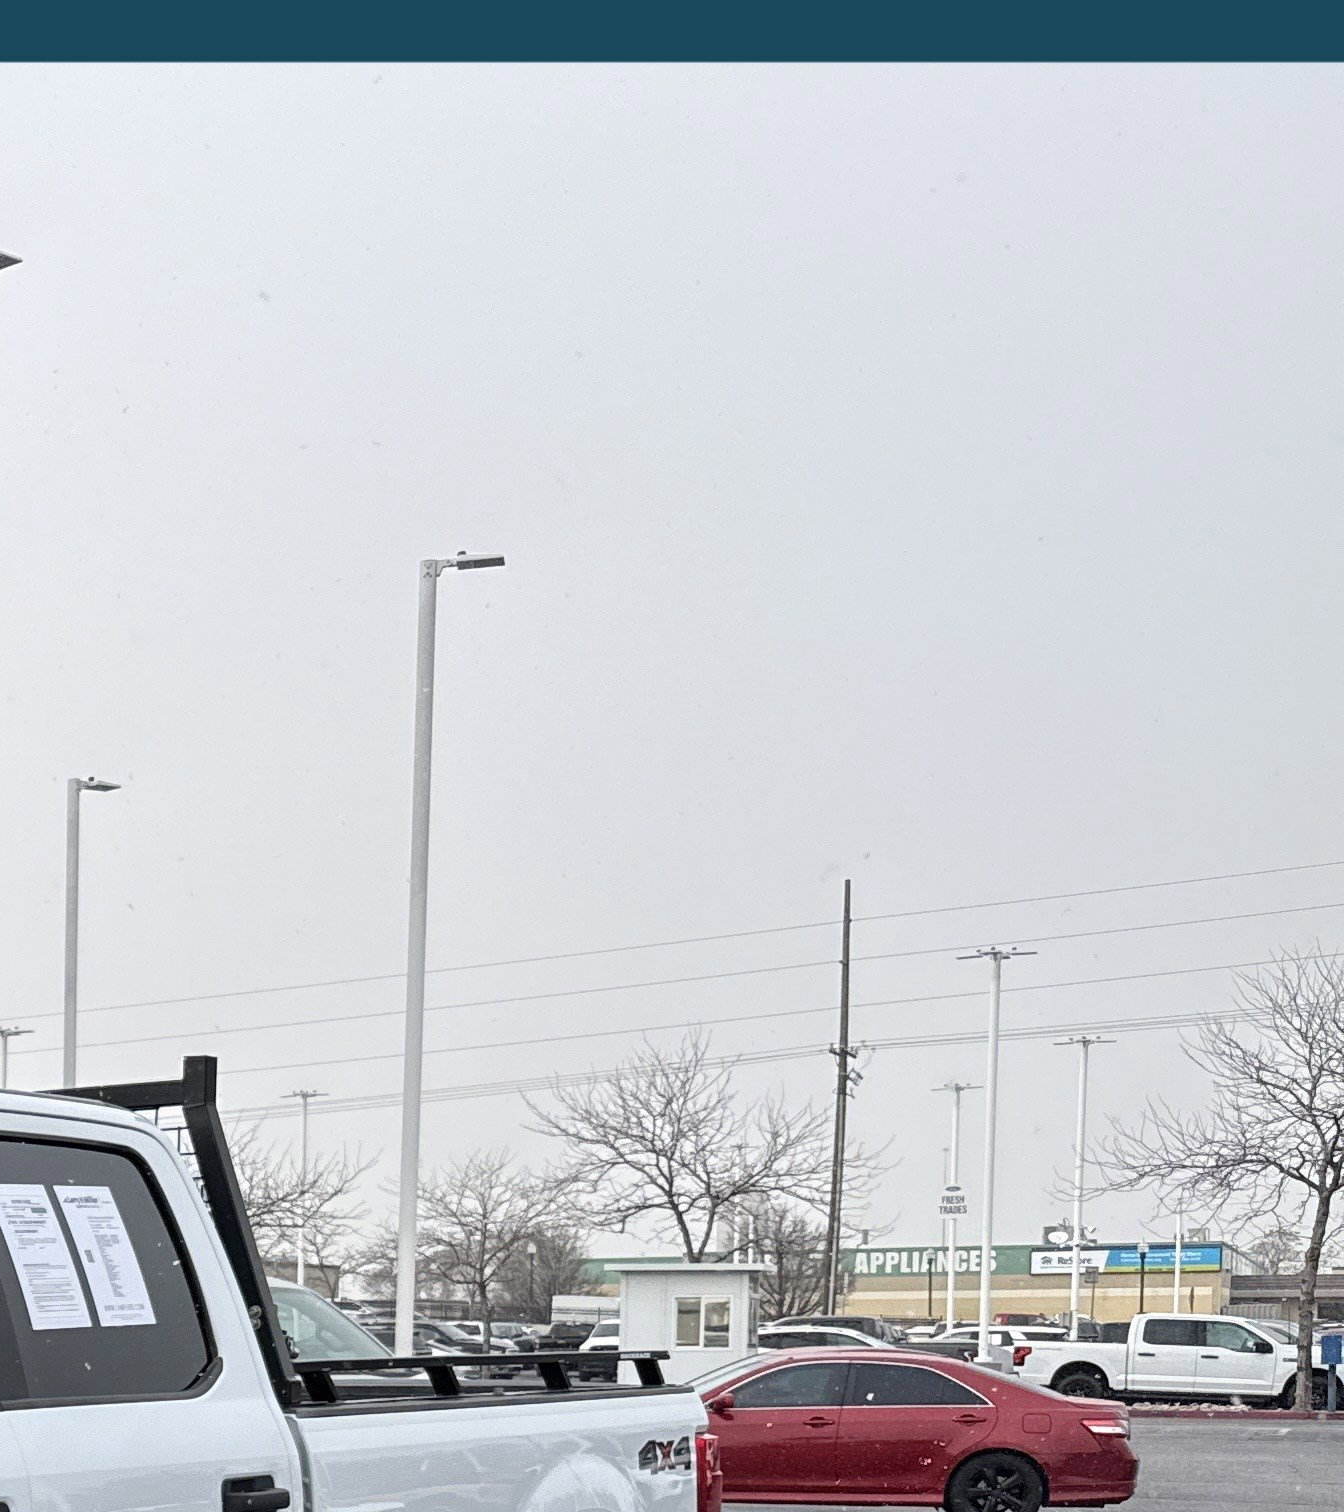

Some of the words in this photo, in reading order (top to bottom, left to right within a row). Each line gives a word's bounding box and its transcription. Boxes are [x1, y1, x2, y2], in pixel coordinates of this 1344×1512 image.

[941, 1195, 965, 1204] FRESH
[939, 1205, 967, 1215] TRADES
[853, 1249, 997, 1274] APPLIANCES
[1058, 1256, 1092, 1265] ReSore
